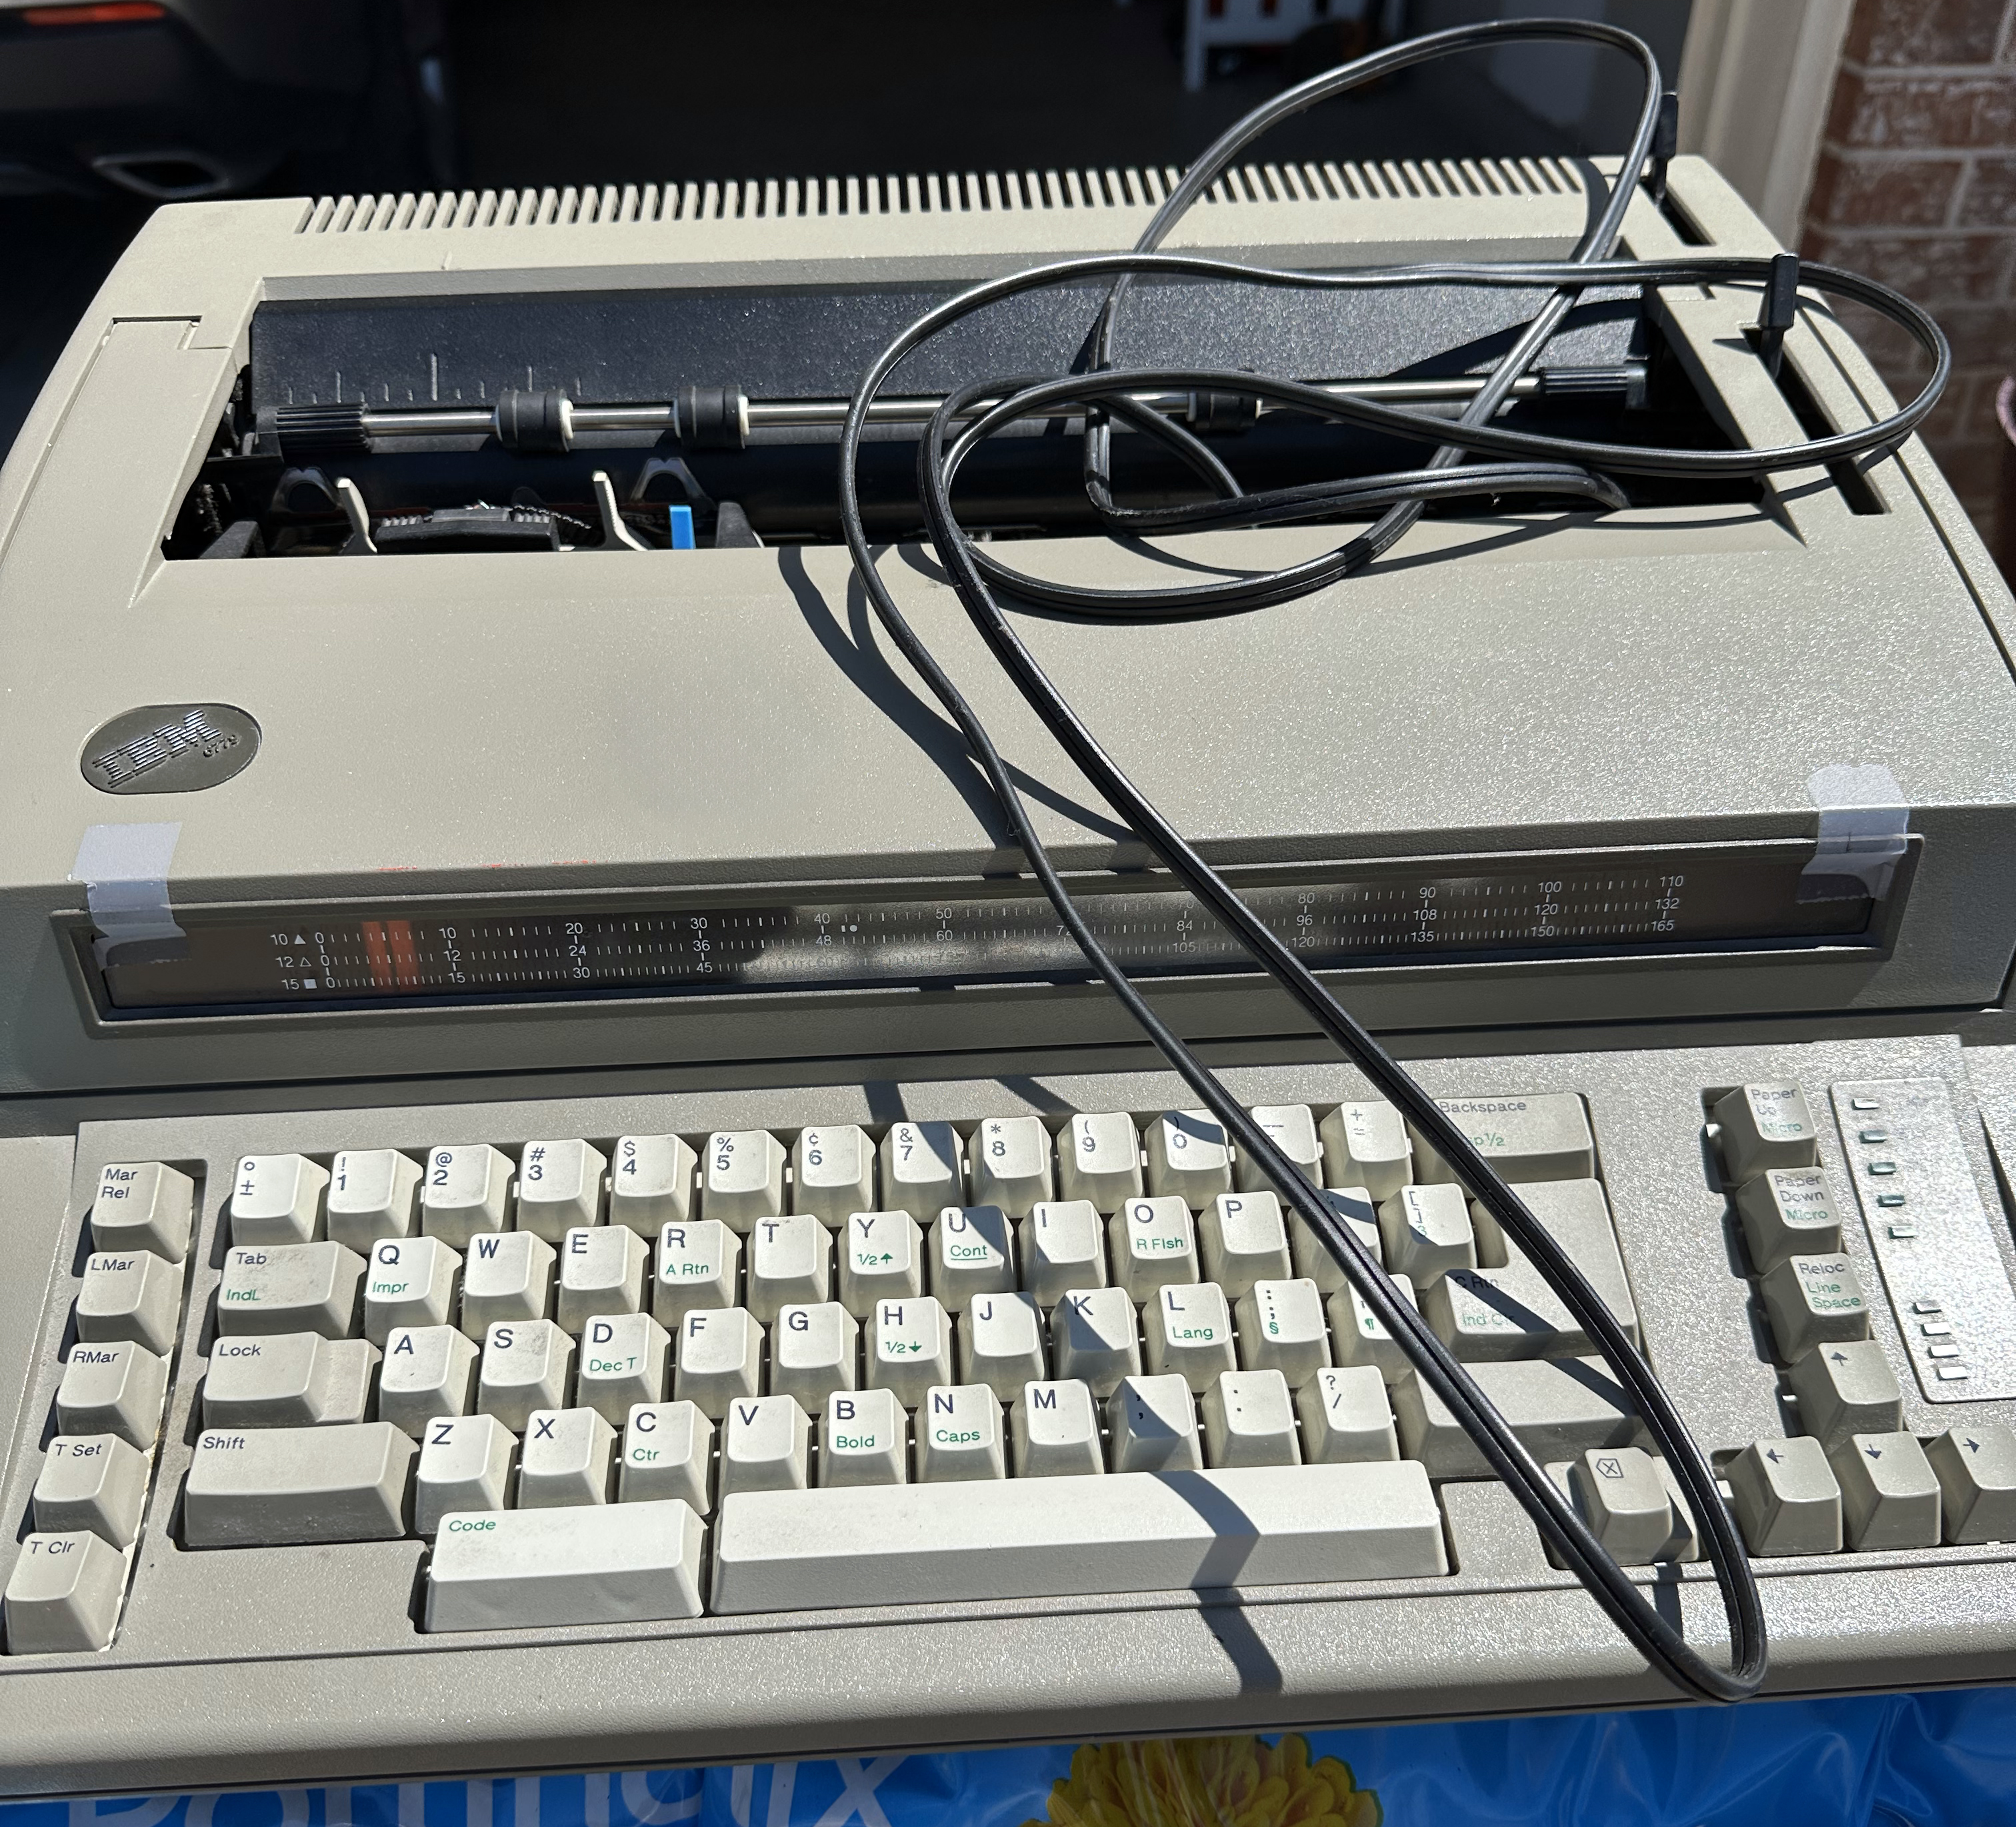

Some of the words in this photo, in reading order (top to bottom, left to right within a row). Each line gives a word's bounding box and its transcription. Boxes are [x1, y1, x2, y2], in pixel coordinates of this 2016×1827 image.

[92, 709, 222, 788] IBM
[271, 934, 288, 946] 10
[316, 932, 325, 944] 0
[440, 927, 457, 940] 10
[565, 922, 583, 934] 20
[691, 918, 708, 930] 30
[814, 913, 831, 925] 40
[935, 907, 953, 920] 50
[1298, 893, 1315, 904] 80
[1419, 887, 1436, 899] 90
[1538, 881, 1562, 893] 100
[1659, 875, 1683, 887] 110
[277, 957, 294, 968] 12
[321, 955, 330, 968] 0
[444, 950, 461, 962] 12
[569, 945, 587, 958] 24
[693, 940, 711, 952] 36
[815, 935, 832, 947] 48
[936, 930, 953, 942] 60
[1177, 920, 1193, 931] 84
[1296, 916, 1313, 926] 96
[1413, 909, 1437, 921] 108
[1535, 903, 1559, 915] 120
[1655, 898, 1679, 909] 132
[282, 979, 300, 990] 15
[326, 977, 335, 988] 0
[449, 973, 466, 984] 15
[573, 967, 591, 980] 30
[696, 962, 713, 974] 45
[1173, 942, 1196, 953] 105
[1293, 937, 1315, 948] 120
[1411, 932, 1434, 943] 135
[1531, 926, 1555, 937] 150
[1651, 920, 1675, 931] 165
[1751, 1088, 1797, 1101] Paper
[1439, 1101, 1527, 1114] Backspace
[624, 1141, 636, 1158] $
[717, 1137, 734, 1152] %
[992, 1141, 1006, 1157] 8
[1082, 1137, 1095, 1152] 9
[435, 1152, 453, 1168] @
[530, 1147, 546, 1162] #
[809, 1150, 823, 1166] 6
[900, 1145, 914, 1162] 7
[623, 1160, 637, 1175] 4
[717, 1155, 730, 1170] 5
[105, 1168, 137, 1181] Mar
[433, 1170, 448, 1186] 2
[529, 1165, 543, 1180] 3
[338, 1174, 347, 1191] 1
[1774, 1175, 1821, 1188] Paper
[102, 1186, 129, 1199] Rel
[1779, 1190, 1824, 1202] Down
[1134, 1204, 1154, 1224] O
[1225, 1200, 1243, 1219] P
[1785, 1209, 1828, 1221] Micro
[949, 1214, 967, 1233] U
[1041, 1208, 1047, 1228] I
[762, 1224, 779, 1243] T
[857, 1218, 875, 1238] Y
[572, 1234, 589, 1254] E
[667, 1228, 685, 1248] R
[1137, 1238, 1148, 1250] R
[379, 1245, 400, 1265] Q
[479, 1239, 500, 1259] W
[950, 1244, 987, 1259] Cont
[237, 1252, 267, 1265] Tab
[666, 1264, 677, 1275] A
[683, 1263, 709, 1275] Rtn
[1799, 1262, 1845, 1274] Reloc
[372, 1282, 409, 1294] Impr
[1454, 1276, 1466, 1288] C
[1471, 1276, 1499, 1288] Rtn
[1806, 1282, 1841, 1293] Line
[226, 1289, 261, 1301] IndL
[1168, 1292, 1185, 1311] L
[979, 1301, 993, 1321] J
[1073, 1296, 1094, 1316] K
[1812, 1297, 1861, 1310] Space
[789, 1311, 809, 1331] G
[885, 1306, 903, 1326] H
[593, 1324, 613, 1343] D
[690, 1317, 707, 1337] F
[1173, 1326, 1213, 1340] Lang
[394, 1334, 414, 1355] A
[494, 1329, 513, 1349] S
[73, 1350, 119, 1363] RMar
[219, 1344, 261, 1357] Lock
[590, 1359, 622, 1372] Dec
[627, 1358, 637, 1369] T
[935, 1394, 953, 1414] N
[1033, 1389, 1057, 1409] M
[739, 1406, 759, 1426] V
[837, 1400, 855, 1420] B
[534, 1419, 556, 1439] X
[636, 1412, 657, 1432] C
[432, 1424, 454, 1445] Z
[836, 1435, 875, 1448] Bold
[937, 1430, 981, 1444] Caps
[56, 1445, 67, 1456] T
[73, 1444, 101, 1457] Set
[203, 1437, 245, 1450] Shift
[633, 1448, 659, 1461] Ctr
[449, 1520, 496, 1532] Code
[31, 1542, 43, 1554] T
[49, 1542, 75, 1554] Clr
